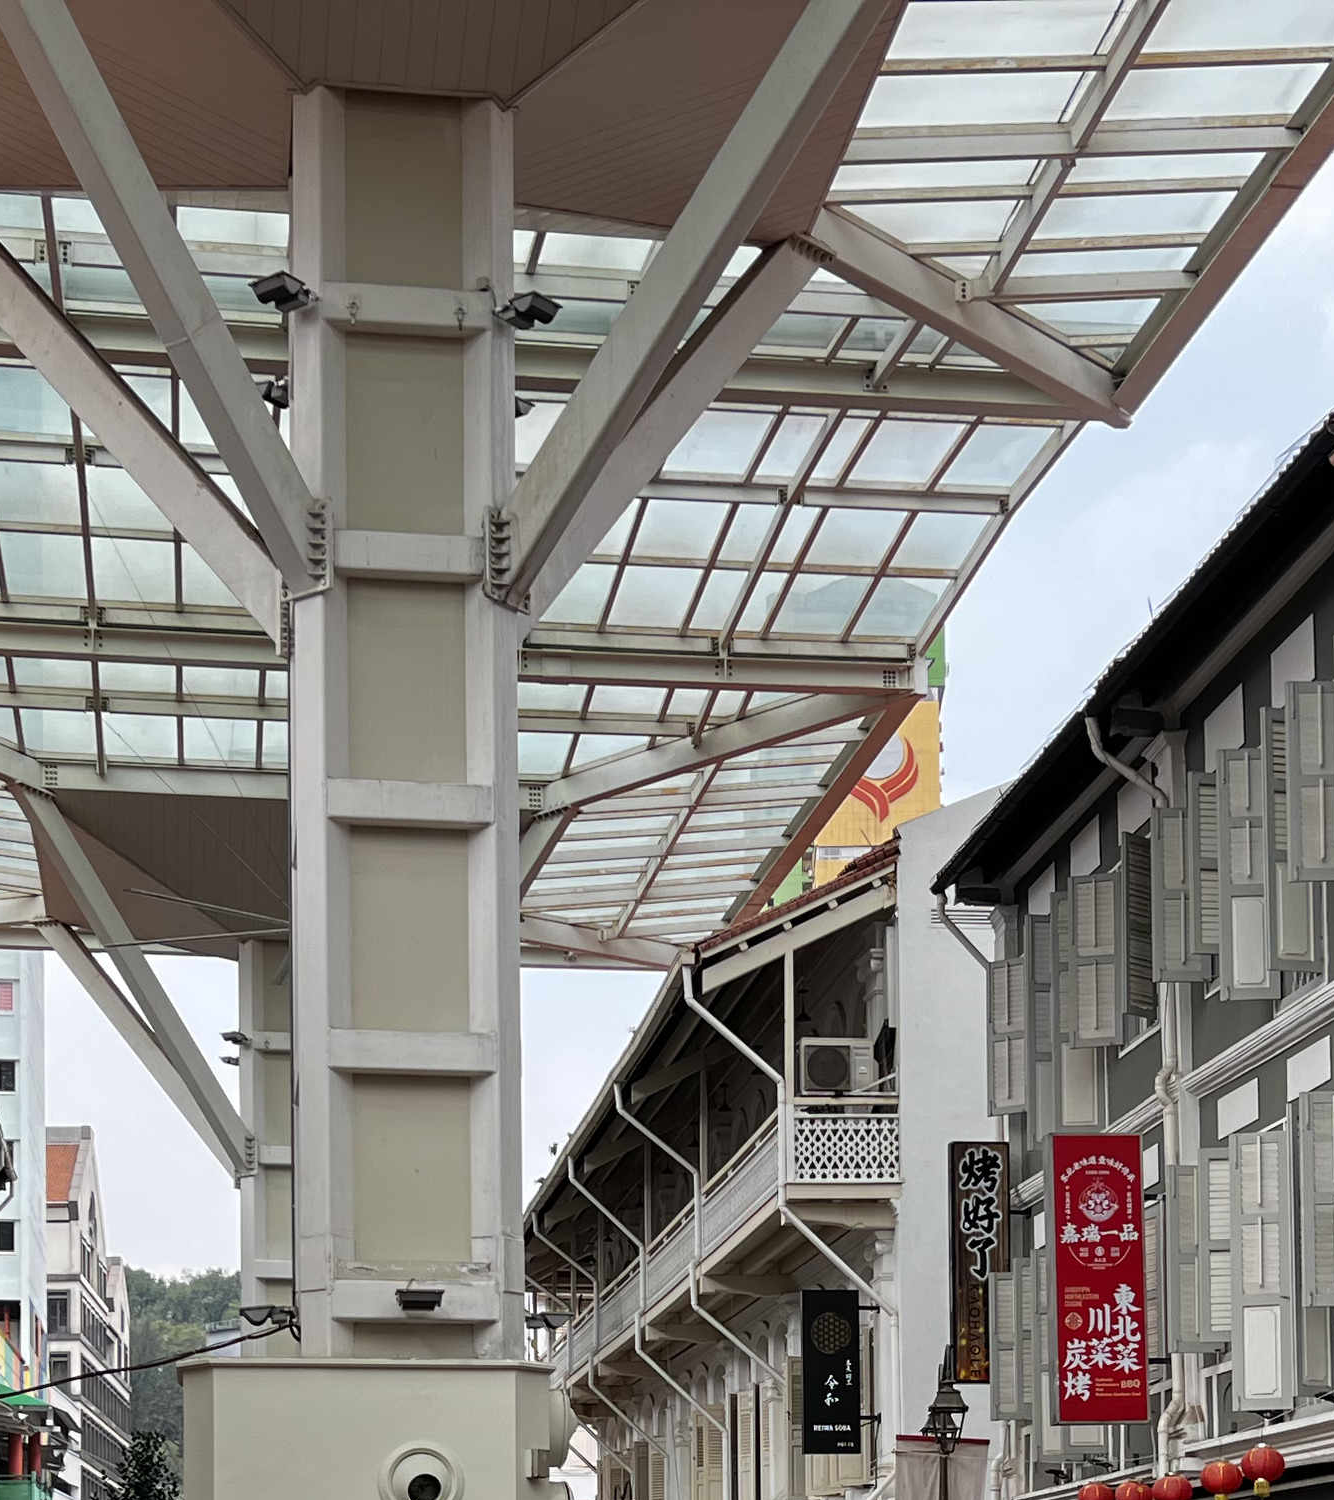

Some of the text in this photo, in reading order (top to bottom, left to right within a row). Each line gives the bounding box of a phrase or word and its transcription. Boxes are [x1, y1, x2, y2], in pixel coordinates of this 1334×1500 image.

[960, 1148, 1001, 1279] 烤好了
[1060, 1222, 1139, 1244] 嘉瑞一品
[1087, 1303, 1116, 1369] 川菜
[1111, 1283, 1143, 1374] 東北菜
[1063, 1338, 1092, 1401] 炭烤
